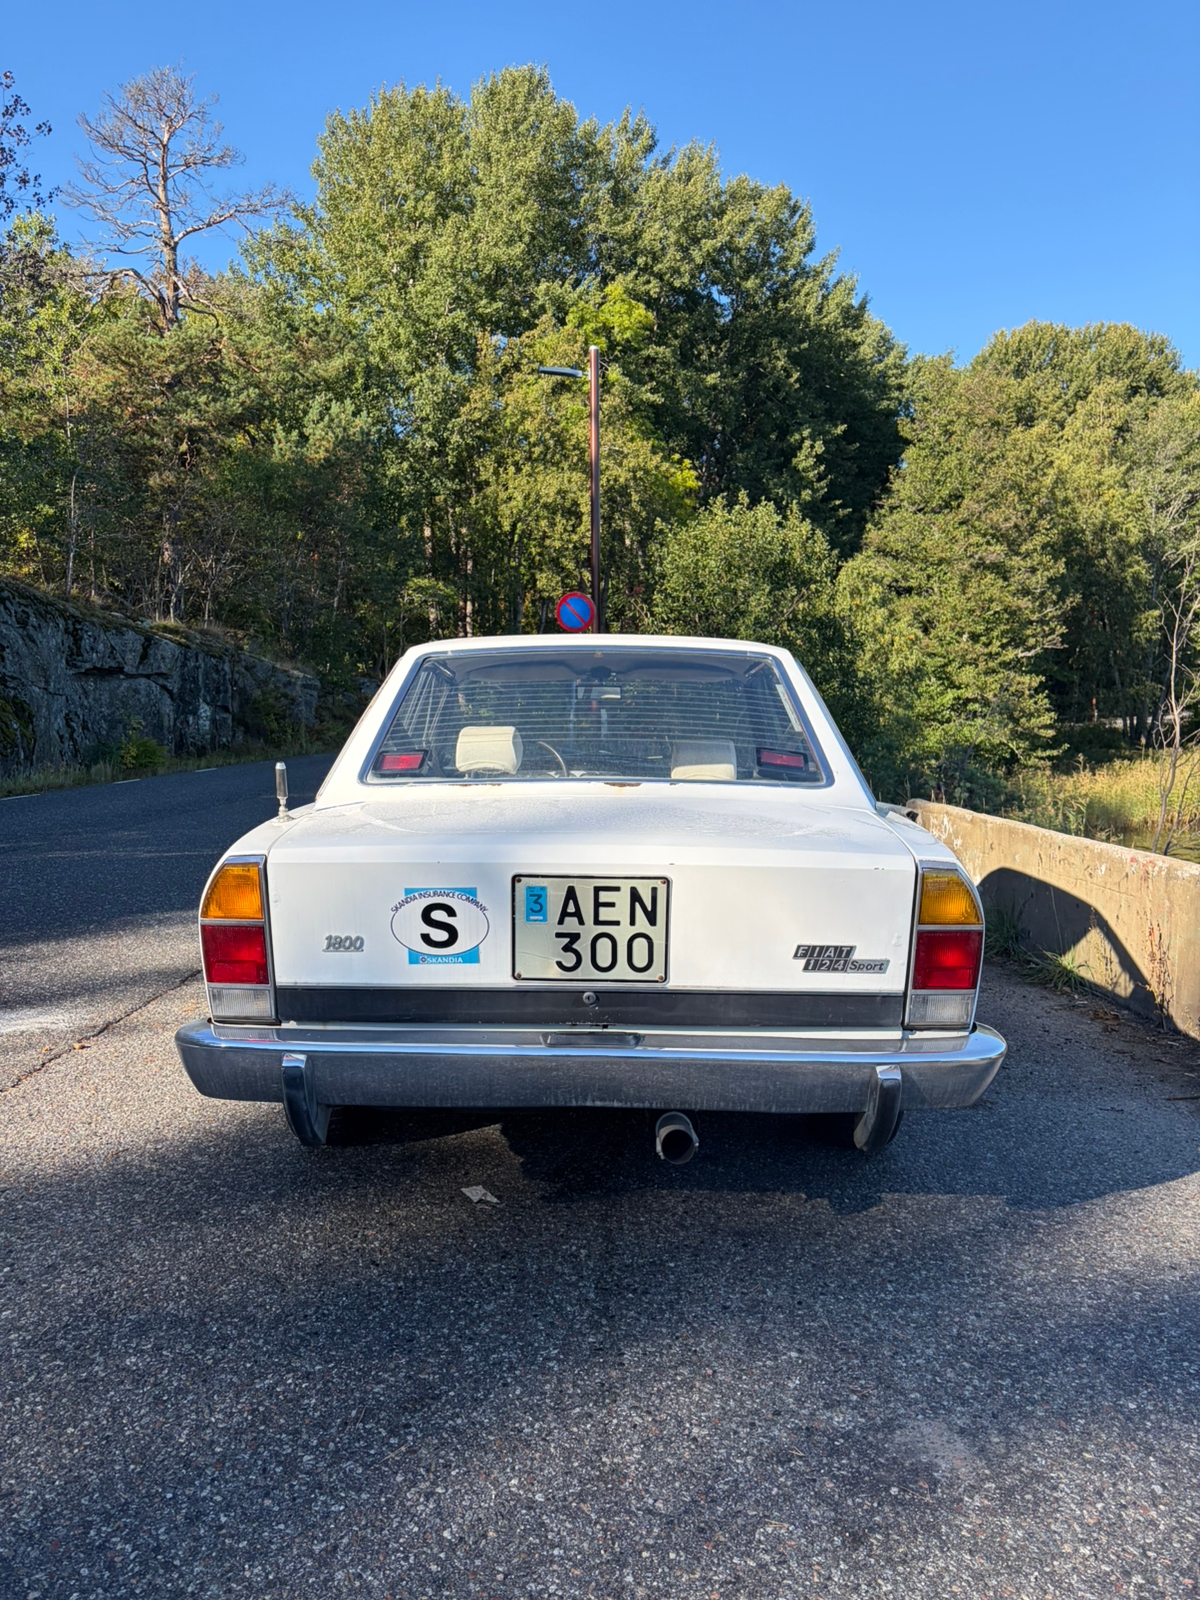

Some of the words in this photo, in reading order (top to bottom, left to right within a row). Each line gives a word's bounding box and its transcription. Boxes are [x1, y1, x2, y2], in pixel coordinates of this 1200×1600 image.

[390, 895, 418, 913] SKANDIA
[418, 890, 456, 900] INSURANCE
[456, 893, 489, 913] COMPANY
[529, 894, 543, 914] 3
[557, 885, 658, 927] AEN
[420, 902, 459, 949] S
[325, 934, 365, 950] 1800
[797, 946, 851, 957] FIAT
[426, 956, 464, 964] SKANDIA
[554, 932, 654, 973] 300
[807, 960, 845, 971] 124
[849, 960, 885, 973] Sport
